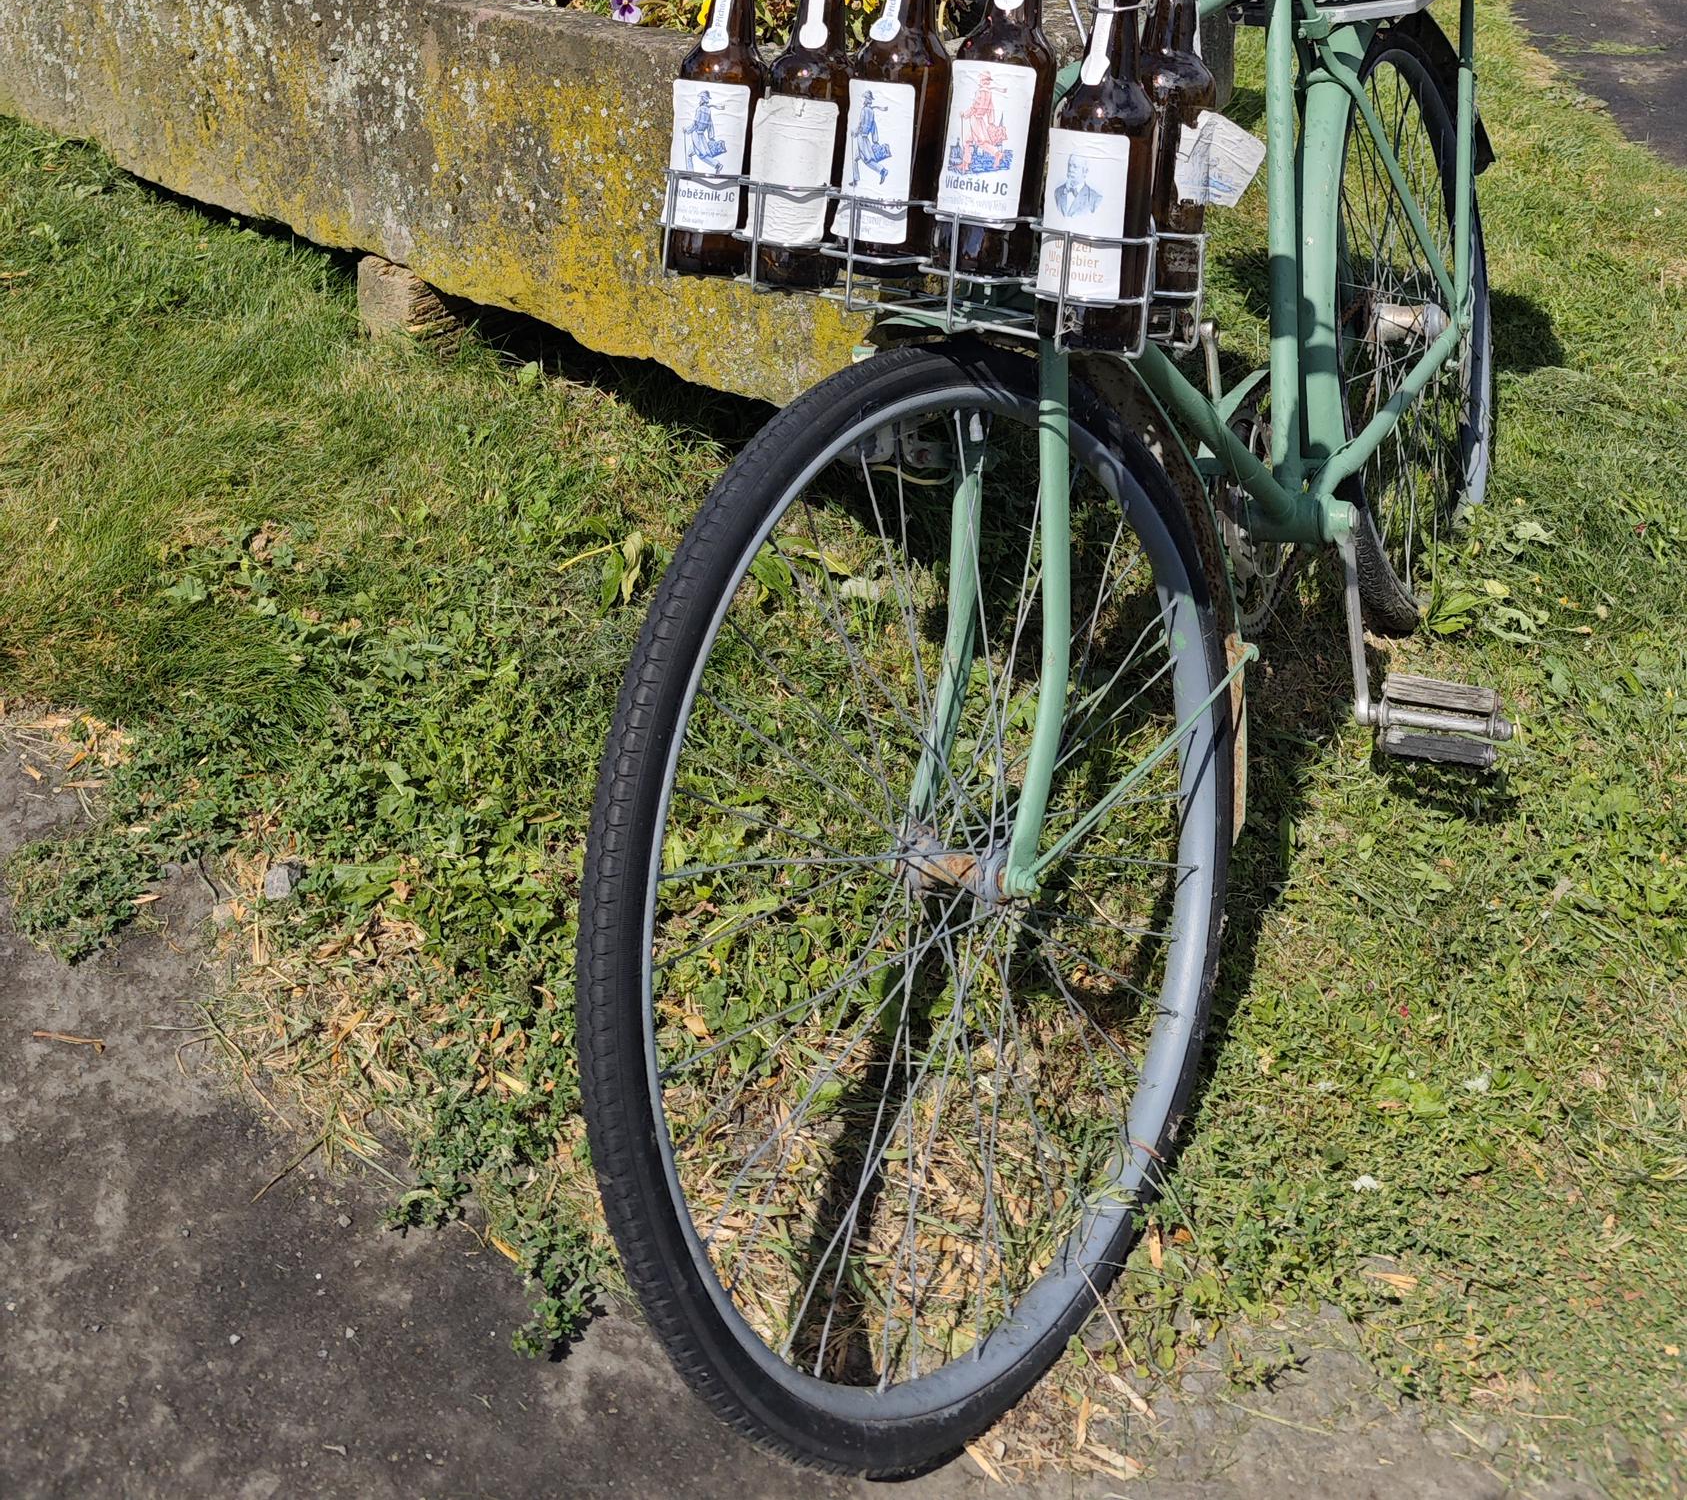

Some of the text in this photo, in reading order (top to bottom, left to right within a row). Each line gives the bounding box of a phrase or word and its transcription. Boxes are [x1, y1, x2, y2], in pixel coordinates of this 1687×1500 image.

[945, 175, 1008, 196] Vídeňák JC
[723, 191, 736, 203] JC
[1054, 236, 1093, 253] Wzel
[1048, 249, 1100, 269] Wesbier
[1044, 263, 1104, 284] Prziowitz
